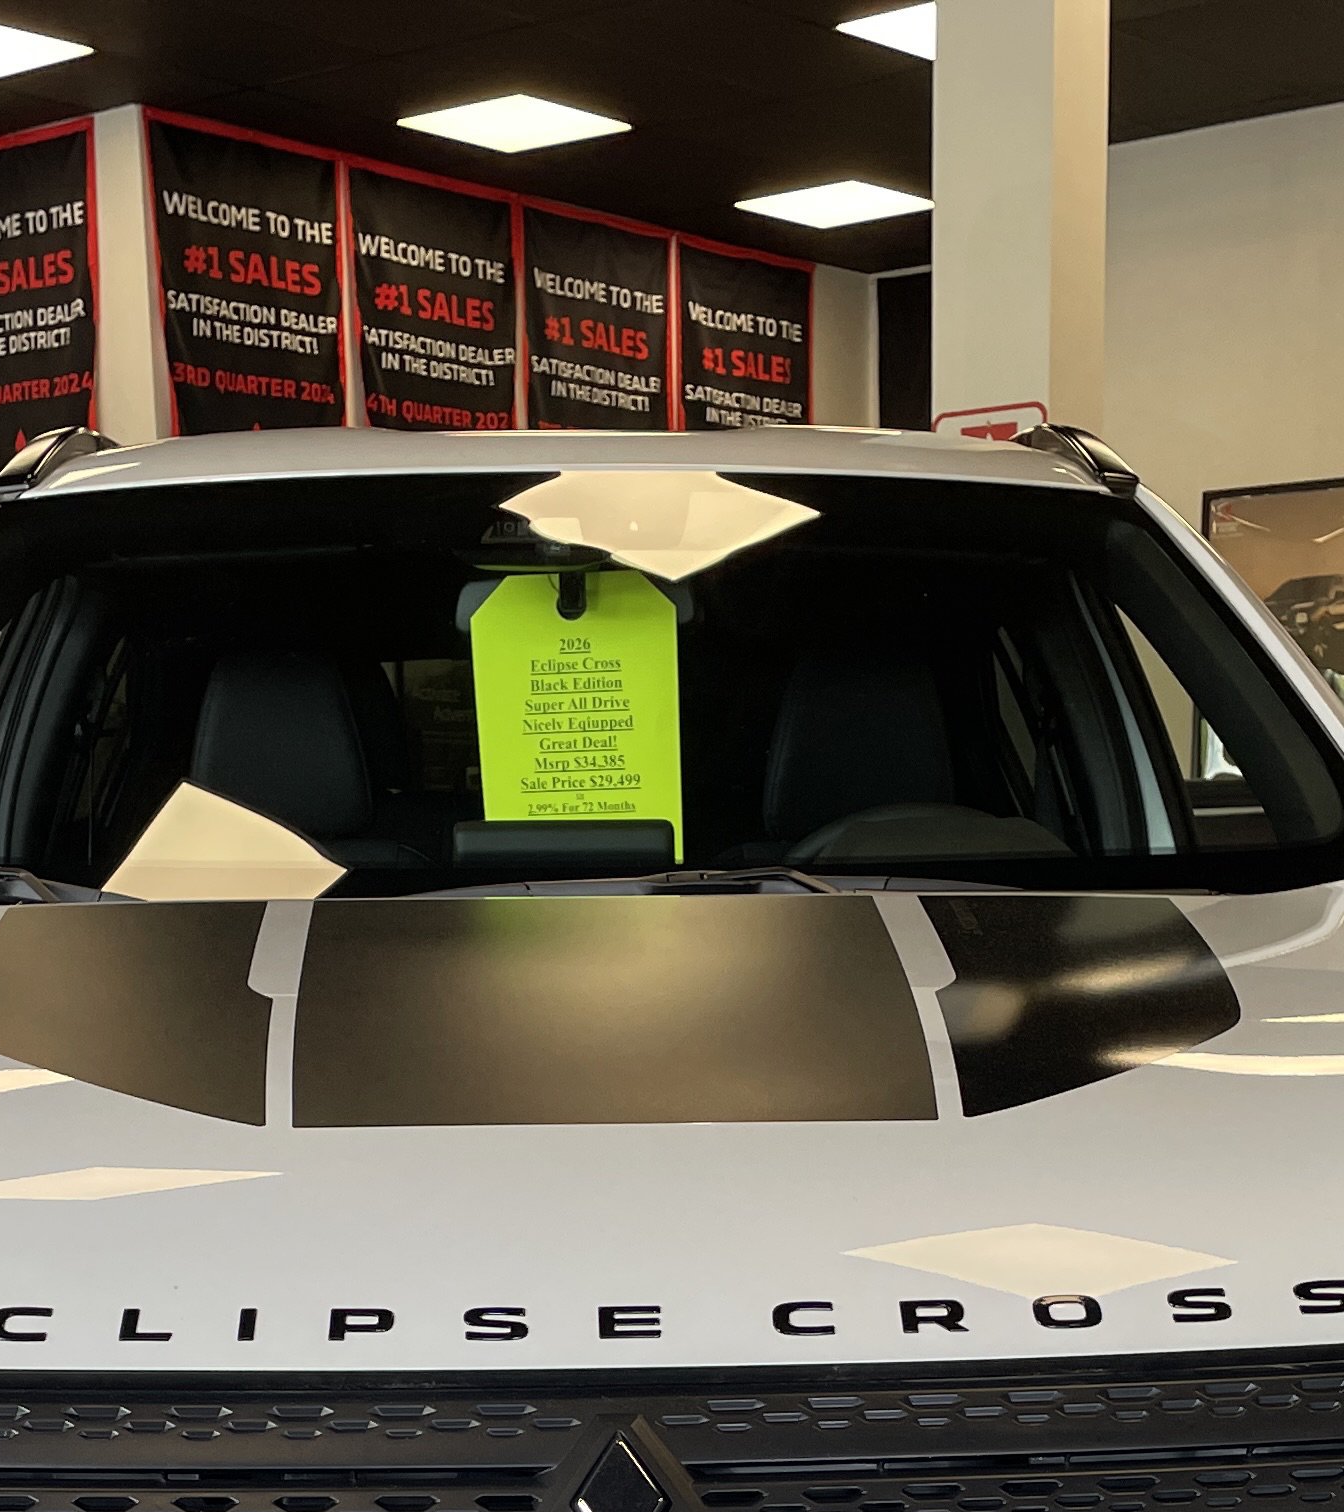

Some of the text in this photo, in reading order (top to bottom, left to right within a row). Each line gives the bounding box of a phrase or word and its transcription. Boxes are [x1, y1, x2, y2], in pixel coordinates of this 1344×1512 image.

[24, 209, 48, 234] TO
[50, 200, 85, 229] THE
[162, 190, 333, 245] WELCOME TO THE
[358, 232, 505, 284] WELCOME TO THE
[183, 245, 321, 296] #1 SALES
[167, 289, 337, 334] SATISFACTION DEALER
[374, 282, 495, 331] #1 SALES
[609, 285, 631, 309] TO
[633, 290, 664, 314] THE
[193, 317, 319, 355] IN THE DISTRICT!
[544, 314, 649, 361] #1 SALES
[756, 315, 777, 337] TO
[381, 352, 400, 371] IN
[402, 354, 428, 376] THE
[458, 344, 515, 366] DEALER
[702, 347, 726, 375] #1
[173, 361, 210, 387] 3RD
[215, 370, 296, 399] QUARTER
[551, 380, 567, 397] IN
[568, 382, 591, 401] THE
[617, 371, 661, 394] DEALE
[367, 392, 397, 417] 4TH
[402, 399, 471, 427] QUARTER
[706, 406, 719, 423] IN
[559, 637, 591, 651] 2026
[531, 656, 621, 673] Eclipse Cross
[531, 676, 623, 692] Black Edition
[524, 695, 630, 714] Super All Drive
[539, 735, 618, 751] Great Deal!
[535, 757, 570, 772] Msrp
[520, 777, 548, 791] Sale
[552, 776, 585, 789] Price
